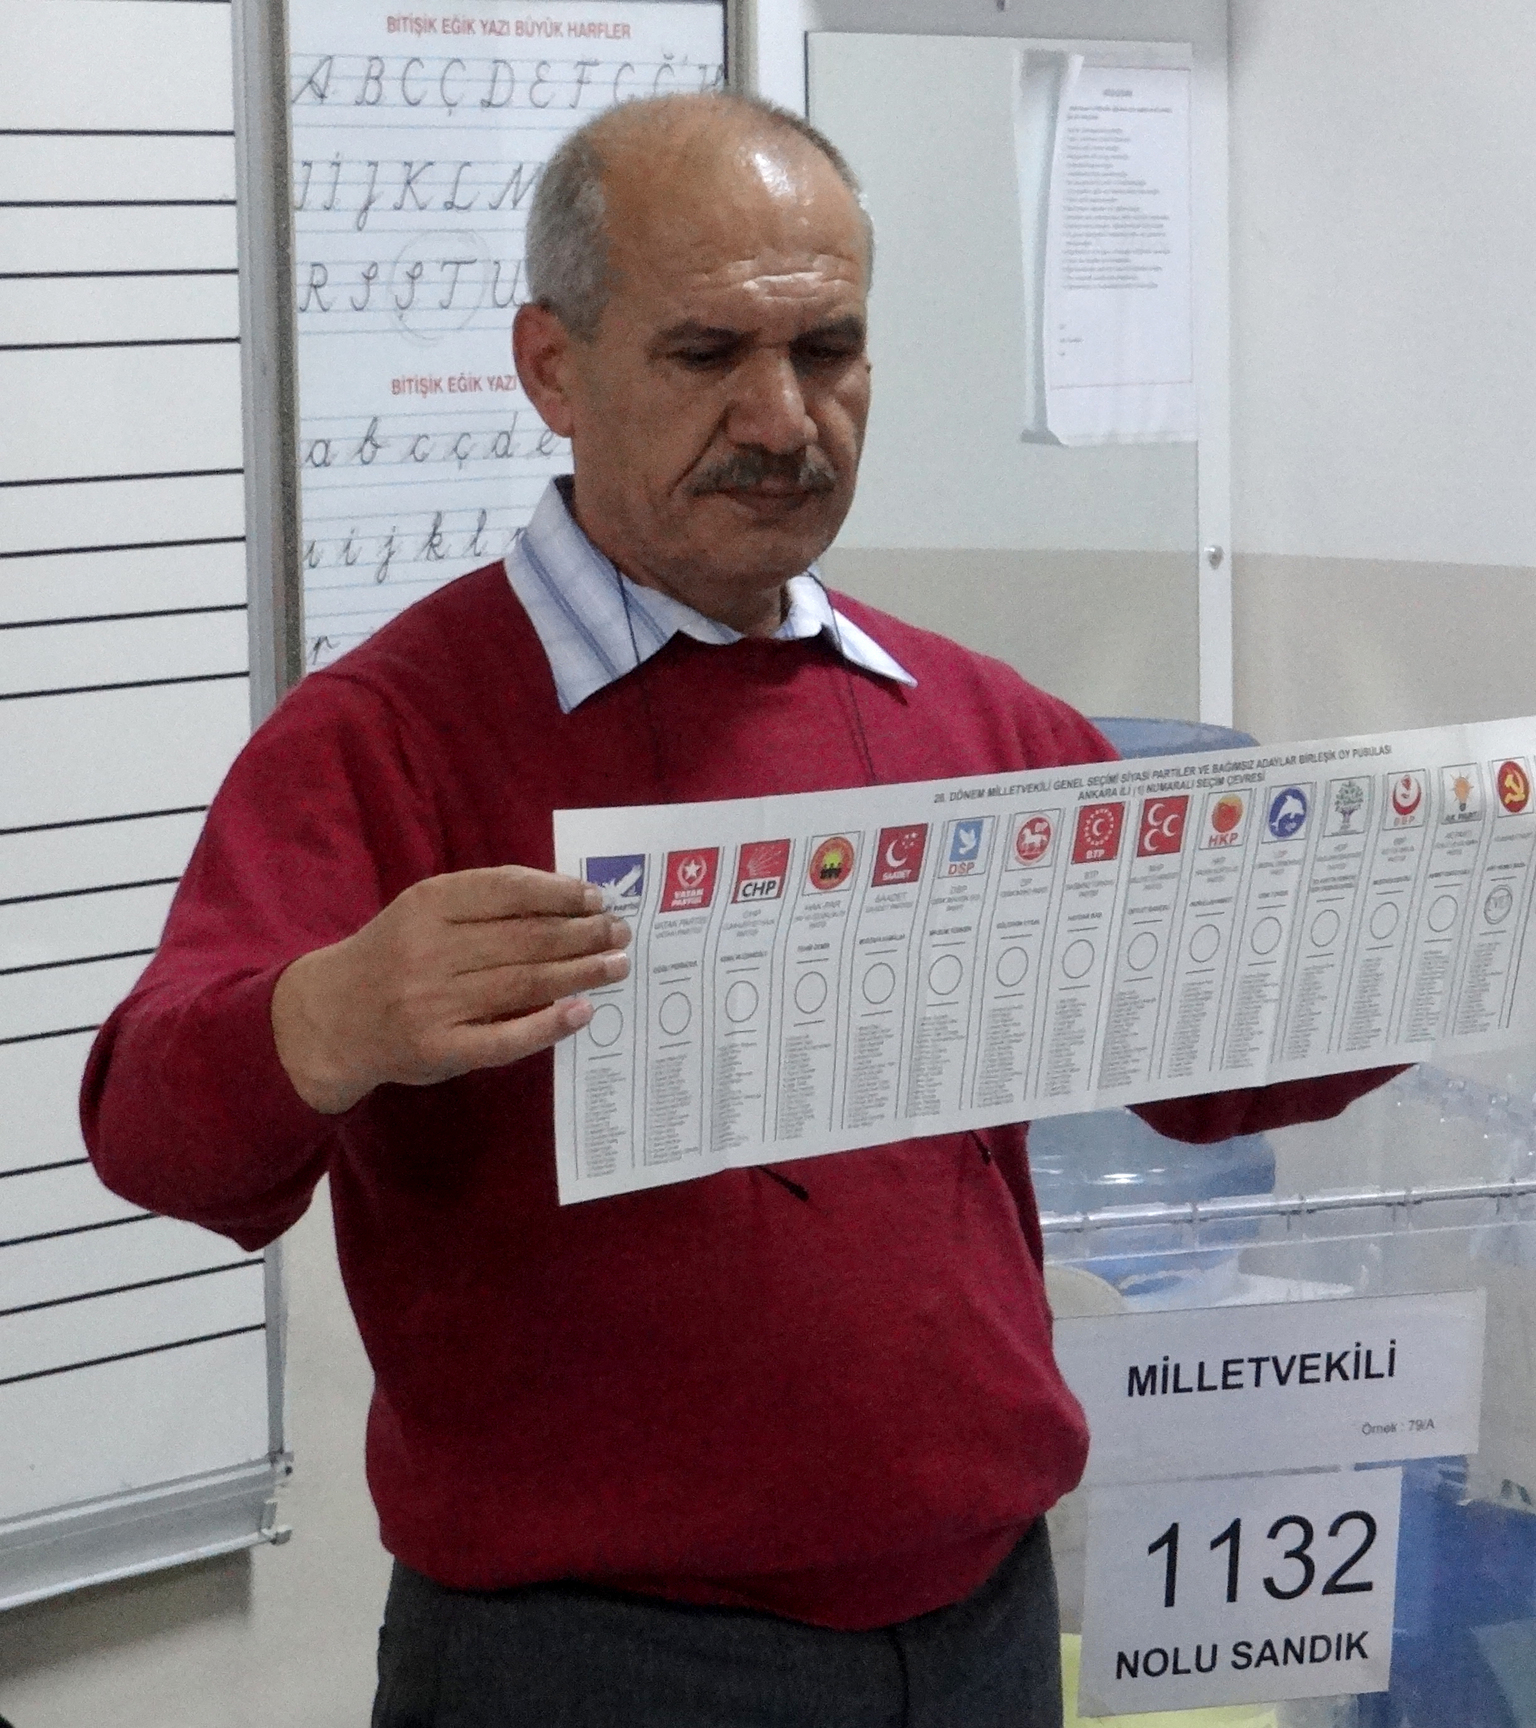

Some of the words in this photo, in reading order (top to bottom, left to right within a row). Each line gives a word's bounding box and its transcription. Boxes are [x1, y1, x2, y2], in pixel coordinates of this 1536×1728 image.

[387, 14, 437, 38] BİTİŞİK
[442, 15, 476, 36] EĞİK
[481, 18, 511, 37] YAZI
[515, 17, 563, 38] BÜYÜK
[567, 22, 632, 40] HARFLER
[355, 56, 385, 106] B
[402, 57, 427, 106] C
[480, 59, 515, 108] D
[393, 161, 436, 211] K
[299, 262, 331, 312] R
[439, 258, 478, 310] T
[391, 374, 442, 398] BİTİŞİK
[447, 373, 483, 394] EĞİK
[487, 375, 518, 391] YAZI
[305, 438, 334, 468] a
[356, 415, 383, 466] b
[409, 434, 431, 463] c
[490, 411, 519, 459] d
[421, 511, 447, 561] k
[1053, 777, 1084, 791] GENEL
[1198, 764, 1210, 775] VE
[1256, 755, 1298, 769] ADAYLAR
[1338, 748, 1351, 759] OY
[1077, 786, 1119, 801] ANKARA
[1208, 832, 1239, 848] HKP
[741, 880, 776, 898] CHP
[948, 862, 975, 876] DSP
[1126, 1338, 1397, 1398] MİLLETVEKİLİ
[1361, 1421, 1398, 1436] Örnek
[1146, 1509, 1379, 1608] 1132
[1115, 1642, 1219, 1681] NOLU
[1230, 1629, 1369, 1672] SANDIK
